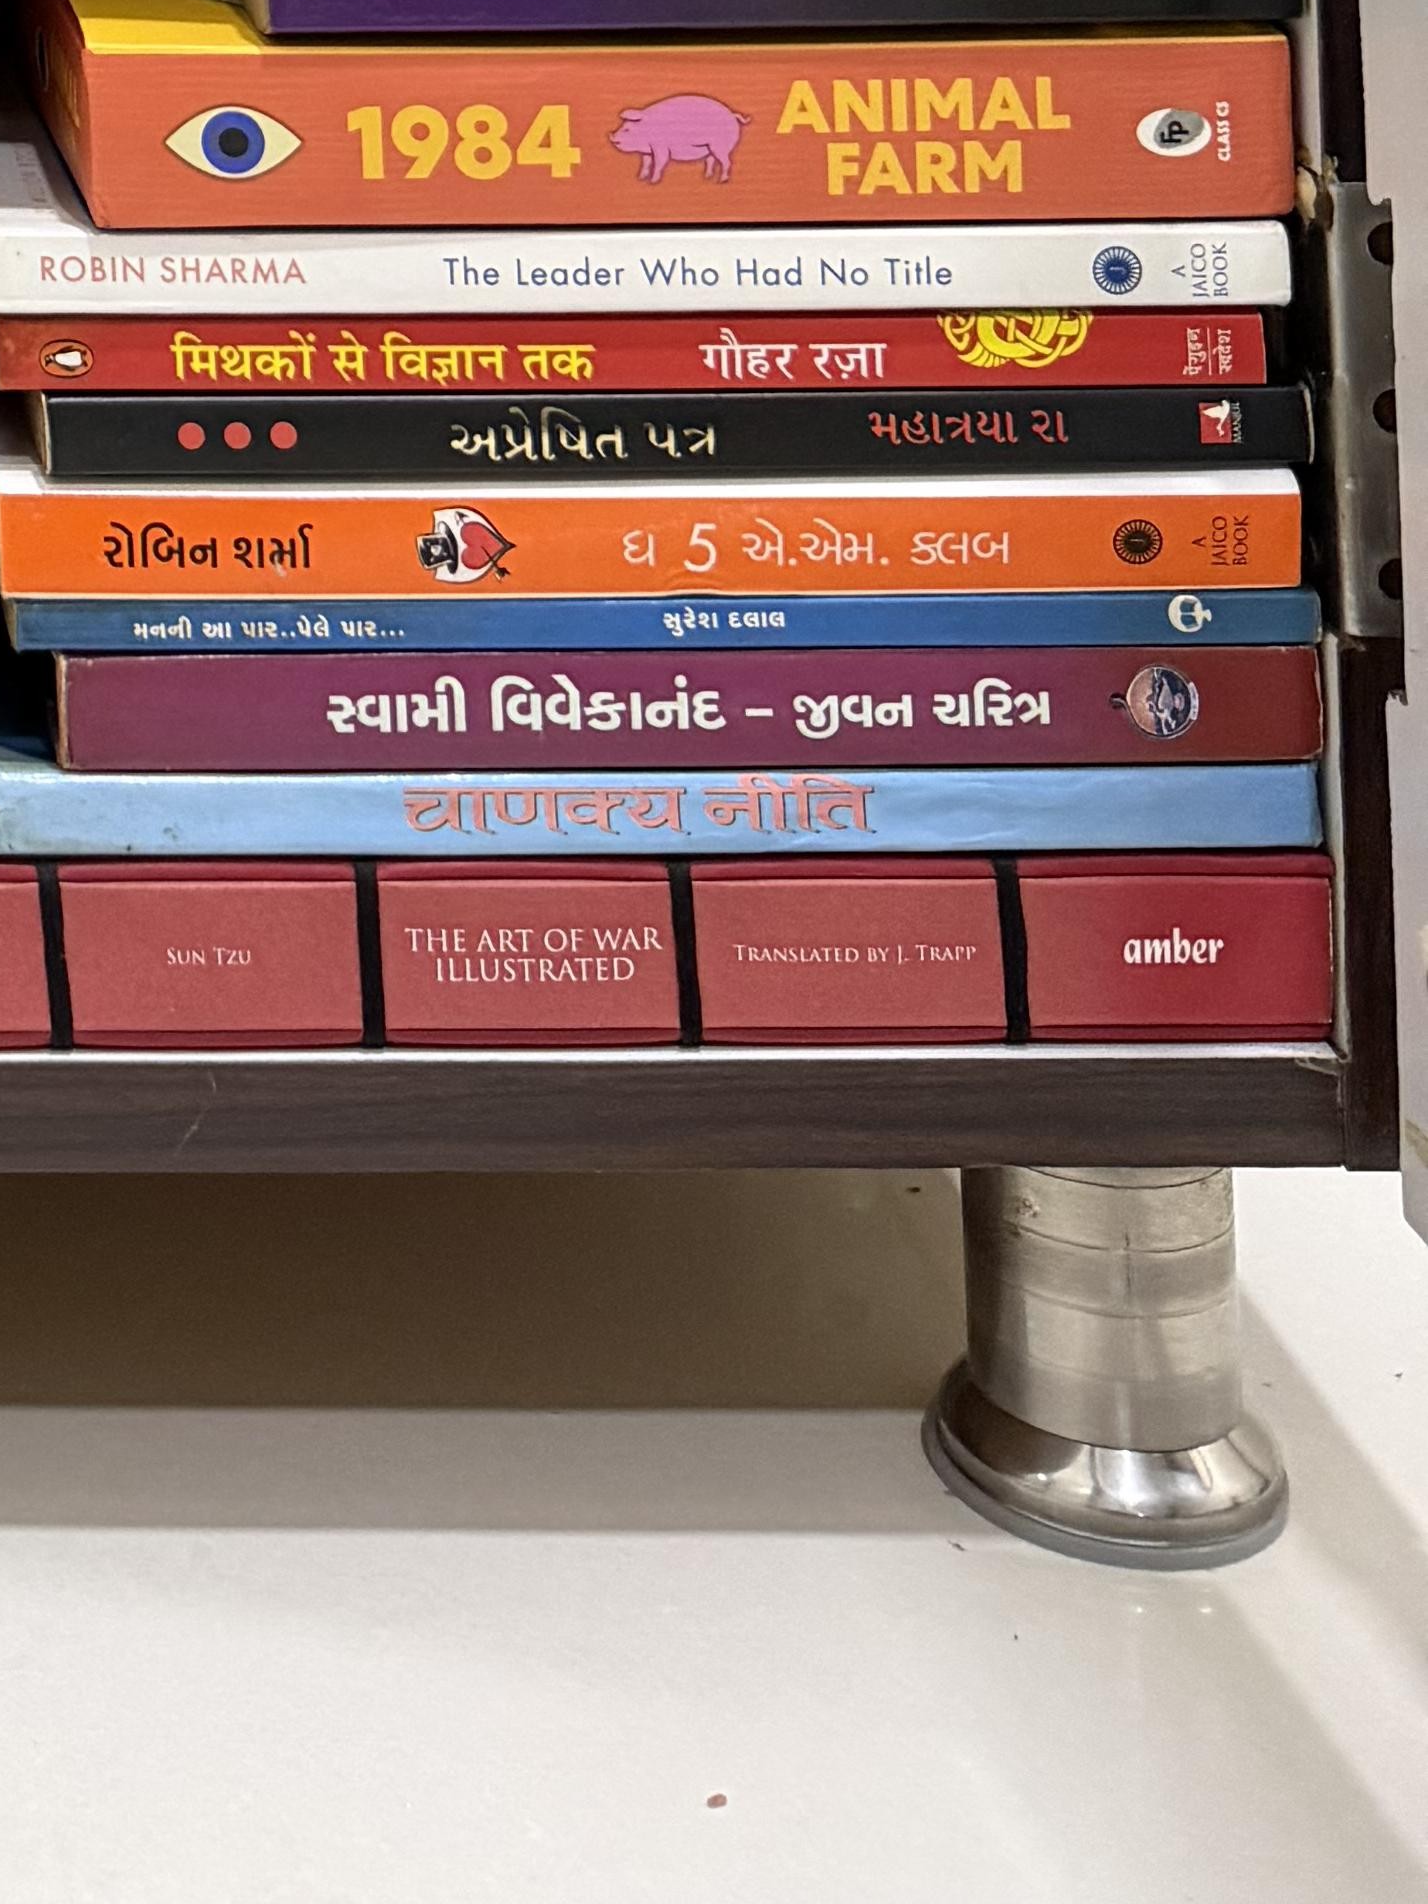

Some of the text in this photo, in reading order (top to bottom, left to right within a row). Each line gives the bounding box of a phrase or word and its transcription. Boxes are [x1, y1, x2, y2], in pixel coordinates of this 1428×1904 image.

[775, 76, 1072, 133] ANIMAL
[345, 105, 582, 181] 1984
[826, 140, 1025, 197] FARM
[405, 926, 664, 953] THE ART OF WAR
[1122, 928, 1225, 966] amber
[433, 954, 636, 983] ILLUSTRATED
